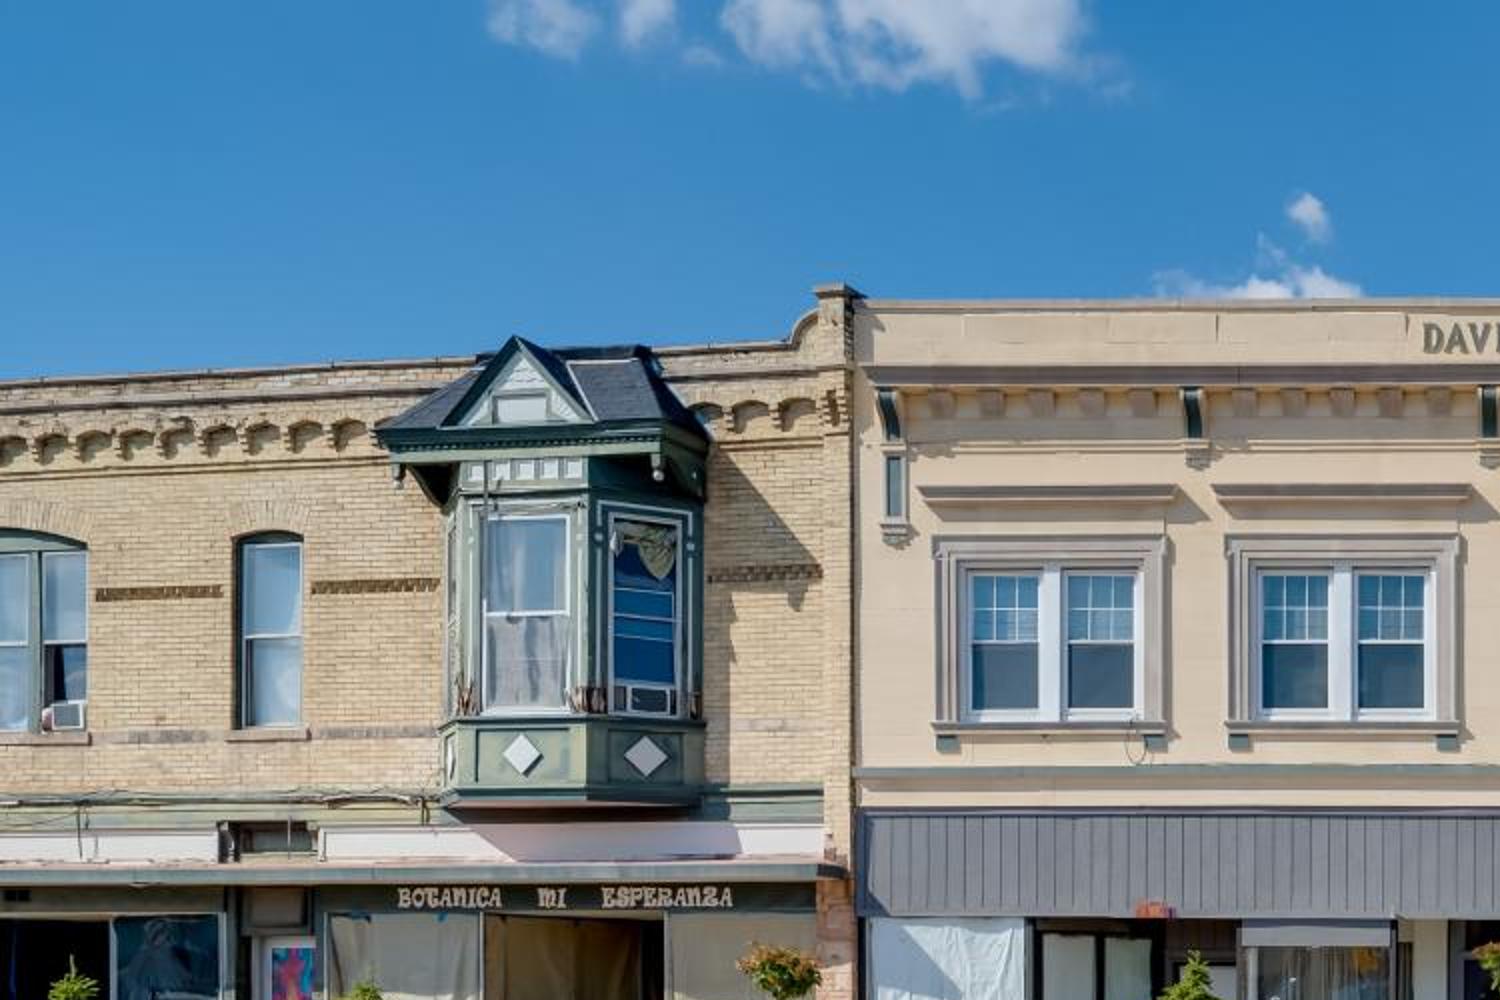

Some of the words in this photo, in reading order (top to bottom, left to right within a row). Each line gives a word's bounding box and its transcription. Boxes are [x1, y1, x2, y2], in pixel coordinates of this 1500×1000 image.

[397, 886, 503, 909] BOTANICA
[537, 887, 567, 909] MI
[601, 886, 734, 908] ESPERANZA
